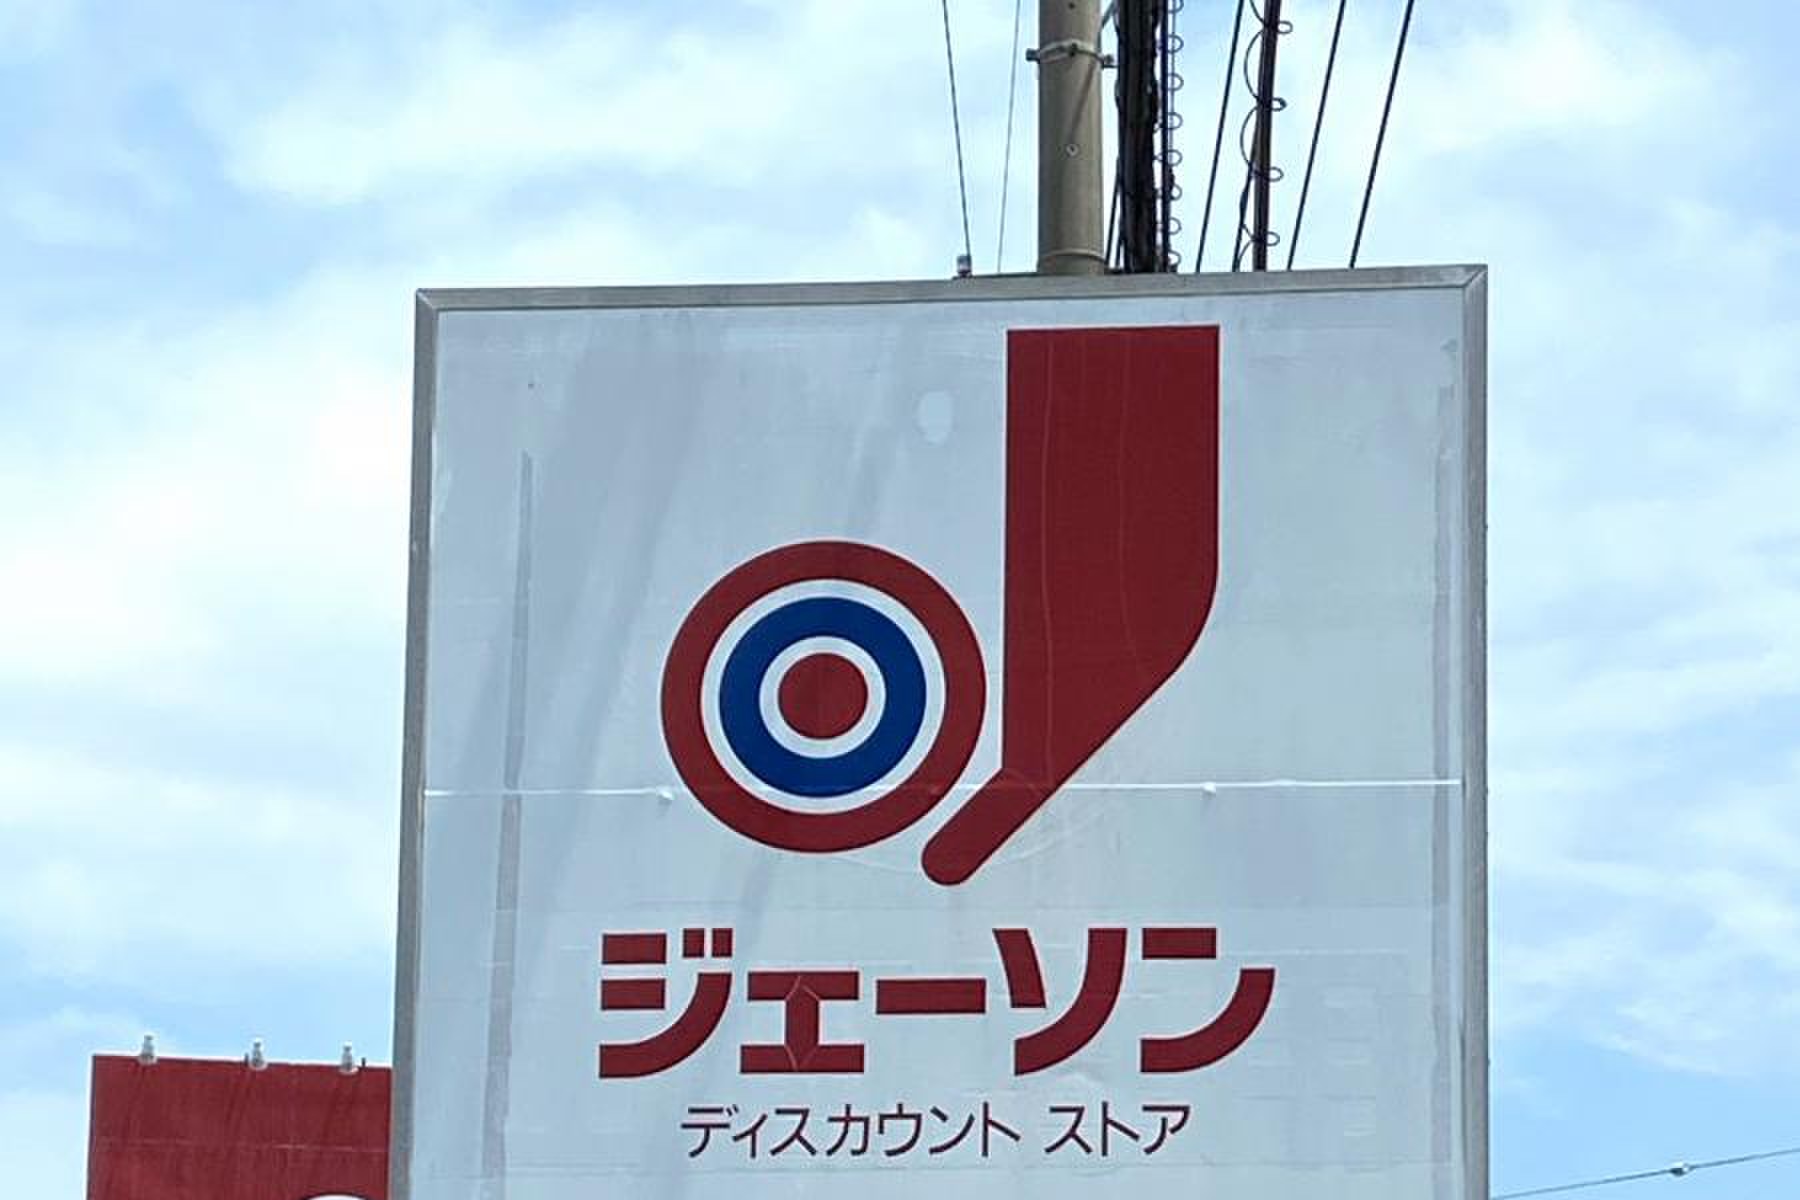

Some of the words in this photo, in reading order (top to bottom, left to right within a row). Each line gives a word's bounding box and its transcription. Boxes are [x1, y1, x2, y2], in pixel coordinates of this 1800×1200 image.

[599, 926, 1276, 1079] ジェーソン
[680, 1101, 1021, 1158] ディスカウント
[1044, 1101, 1191, 1158] ストア
